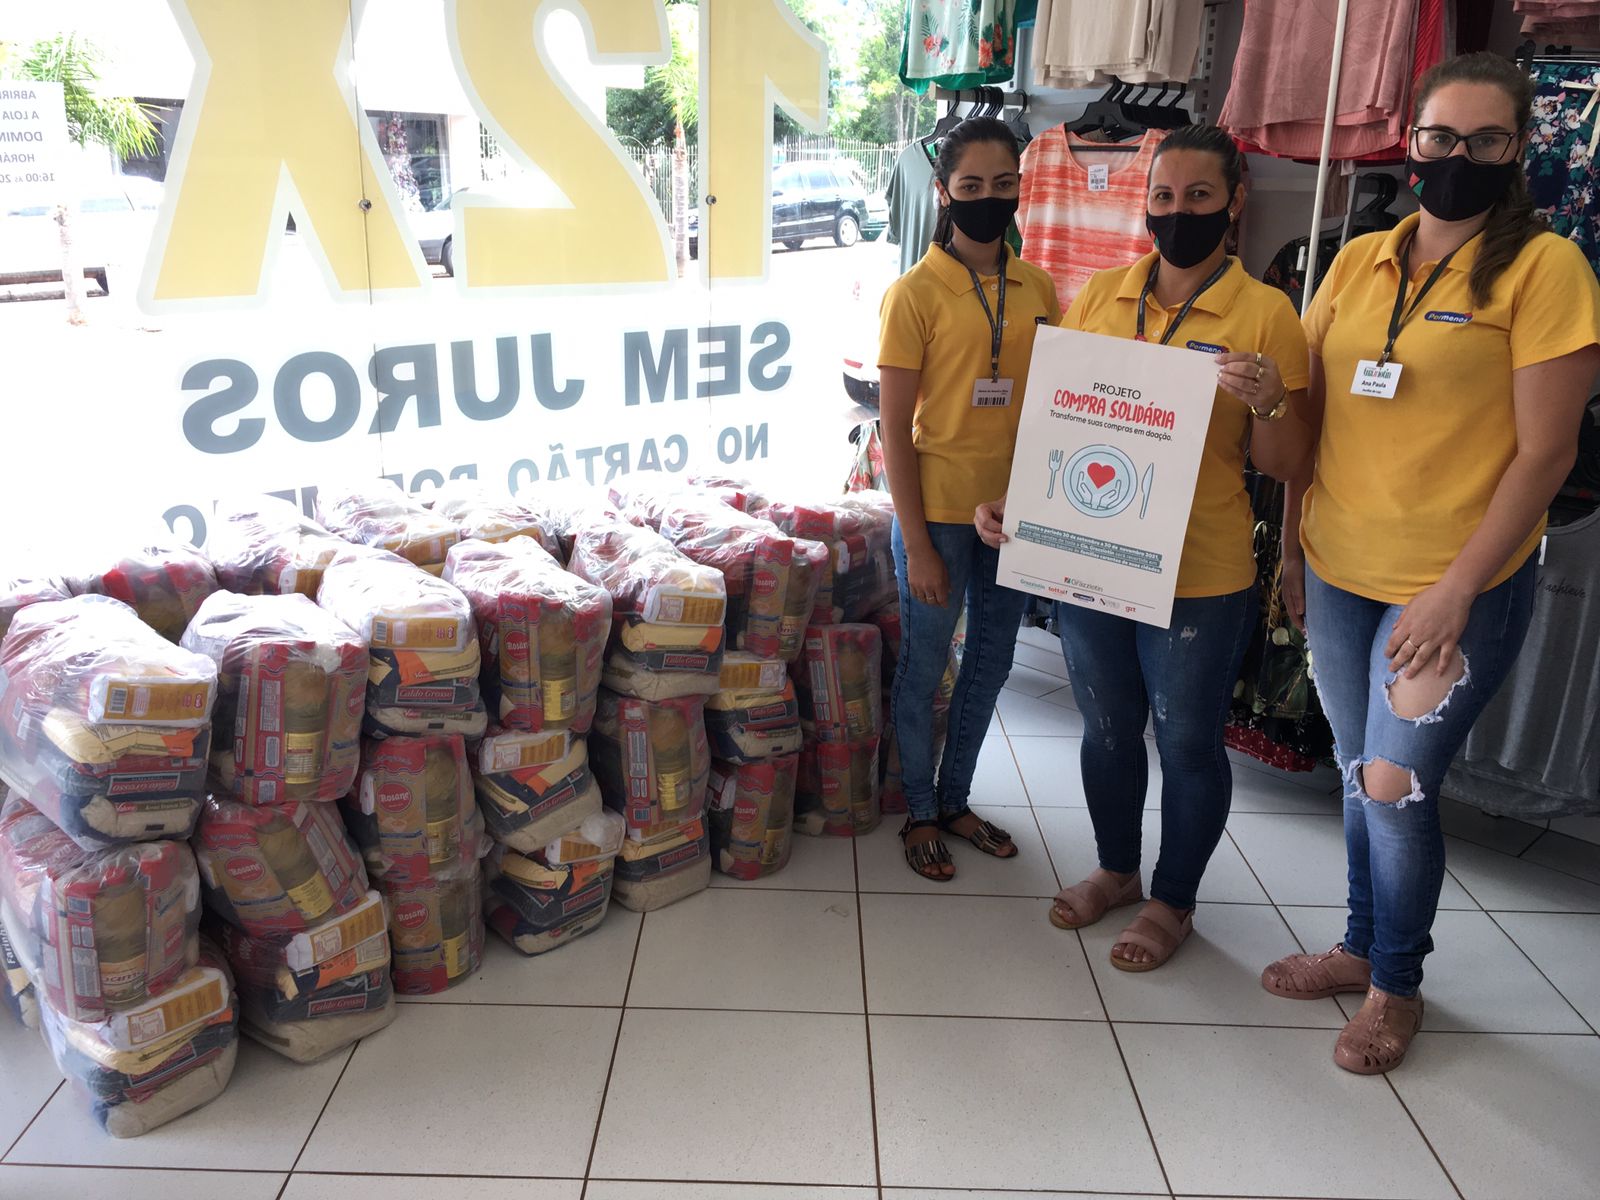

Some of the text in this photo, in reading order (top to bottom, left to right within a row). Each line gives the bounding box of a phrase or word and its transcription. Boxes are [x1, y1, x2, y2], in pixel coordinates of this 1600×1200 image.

[1093, 382, 1141, 400] PROJETO
[1054, 389, 1175, 431] COMPRA SOLIDÁRIA
[1049, 410, 1087, 424] Transforme
[1087, 417, 1103, 427] suas
[1103, 421, 1133, 434] compras
[1133, 427, 1145, 435] em
[399, 688, 452, 697] Caldo Grosso
[380, 791, 410, 803] Rosane
